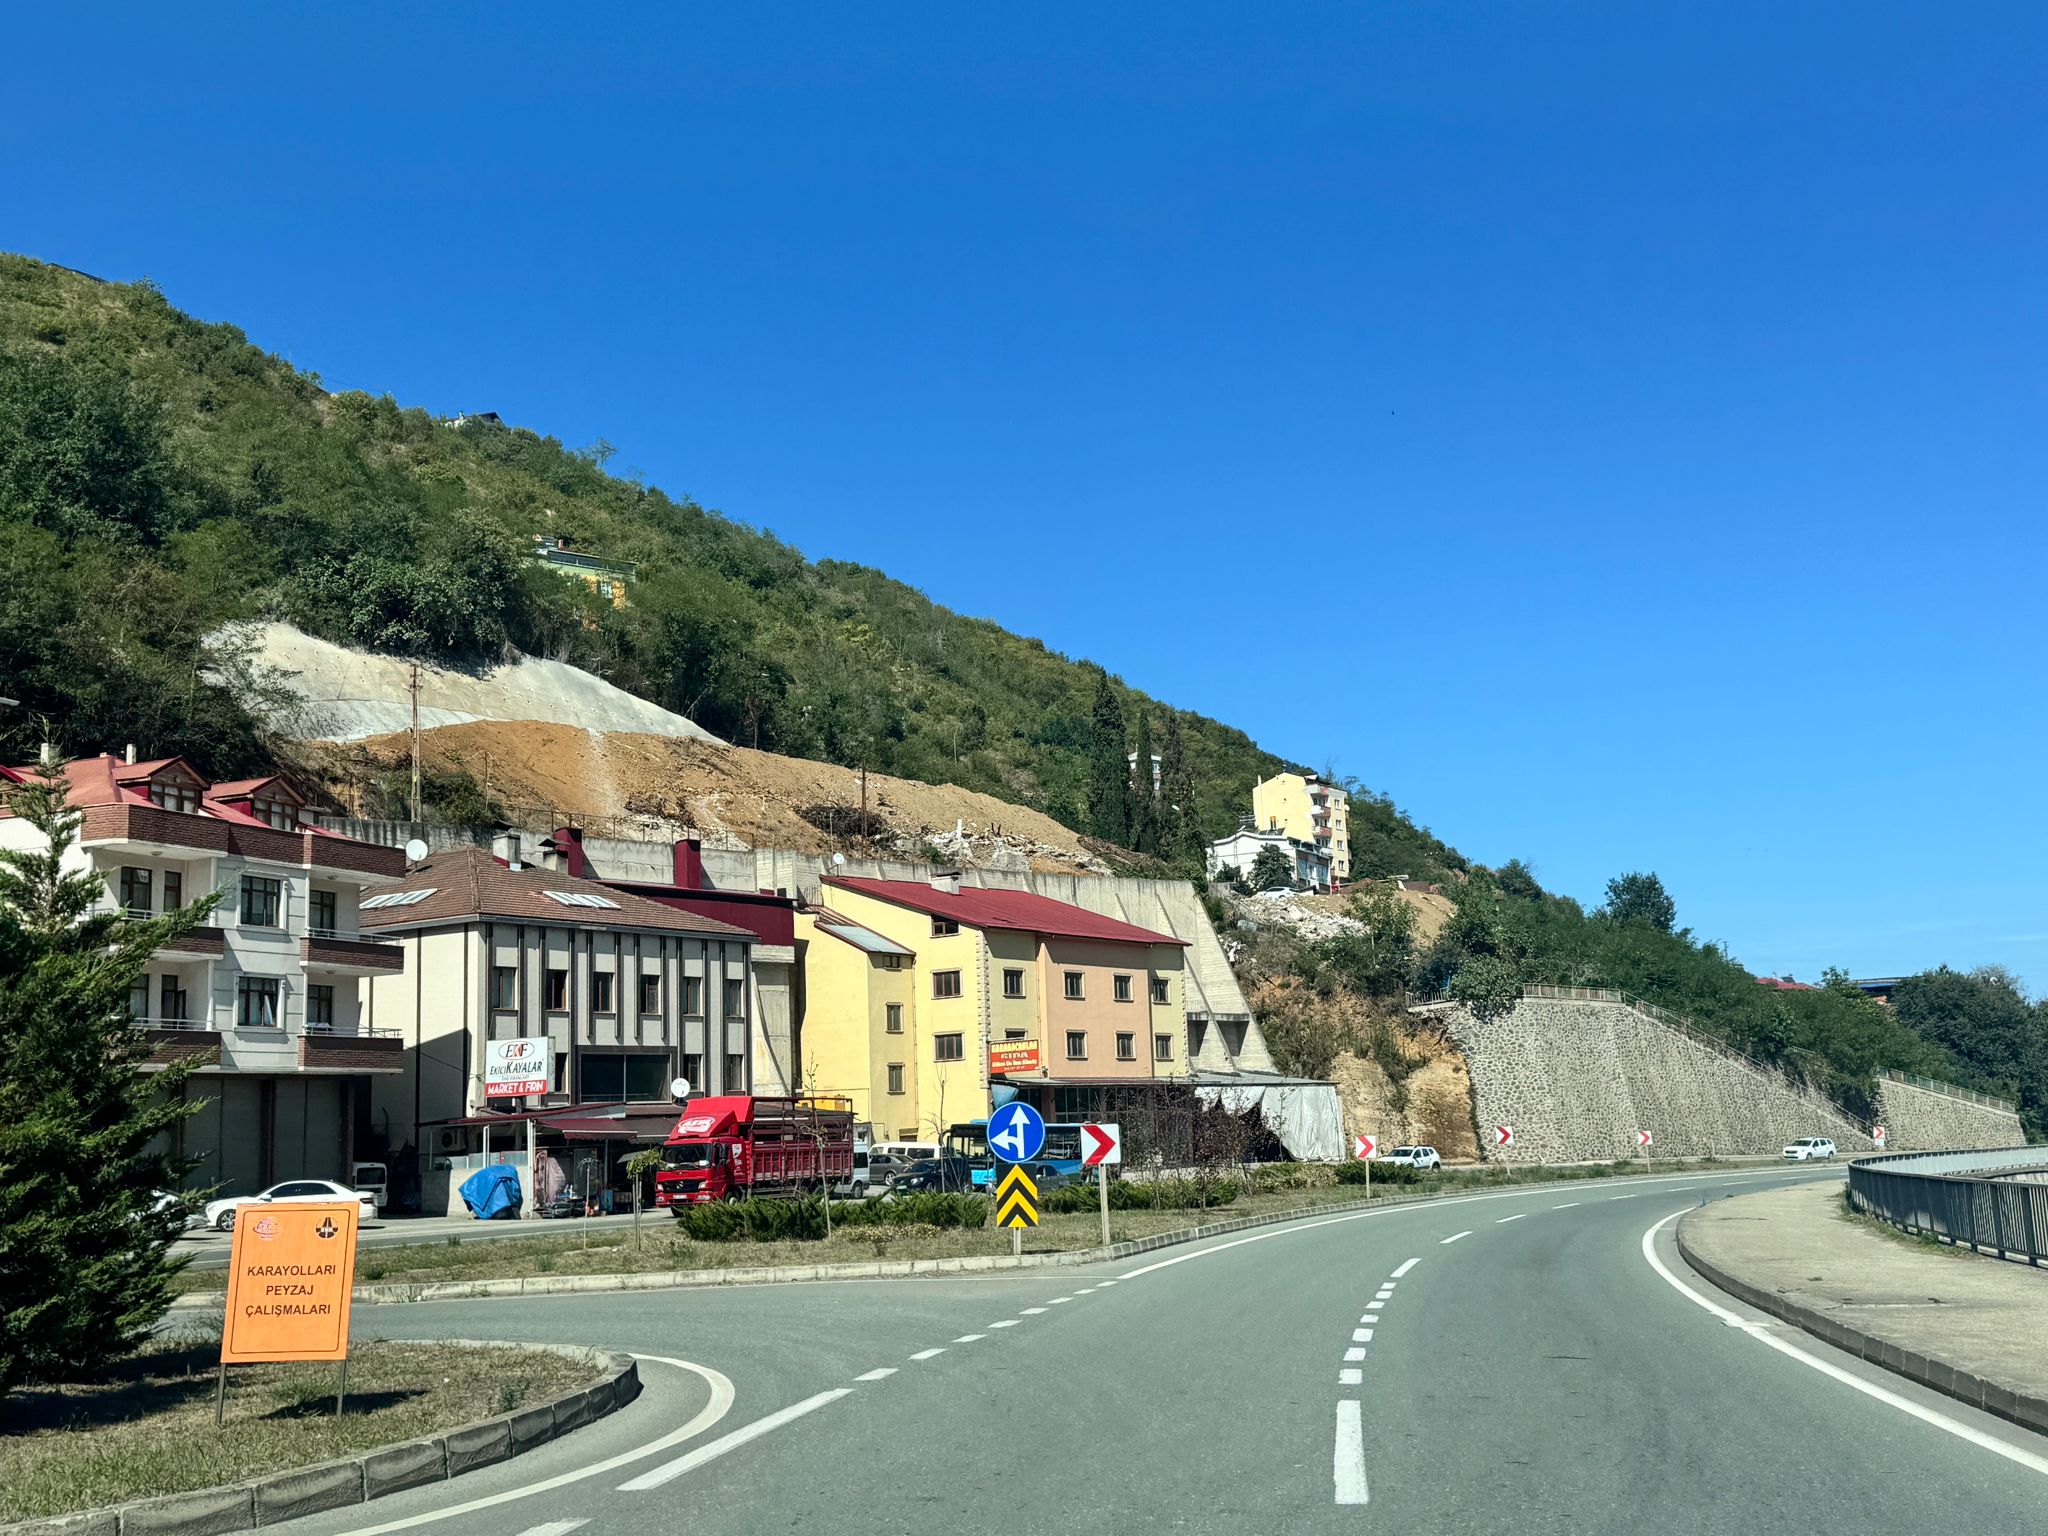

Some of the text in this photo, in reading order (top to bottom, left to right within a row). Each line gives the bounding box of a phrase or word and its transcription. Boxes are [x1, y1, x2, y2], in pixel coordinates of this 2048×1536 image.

[488, 1083, 518, 1095] MARKET
[519, 1082, 524, 1093] &
[247, 1265, 336, 1276] KARAYOLLARI
[266, 1285, 314, 1295] PEYZAJ
[245, 1304, 331, 1317] ÇALIŞMALARI
